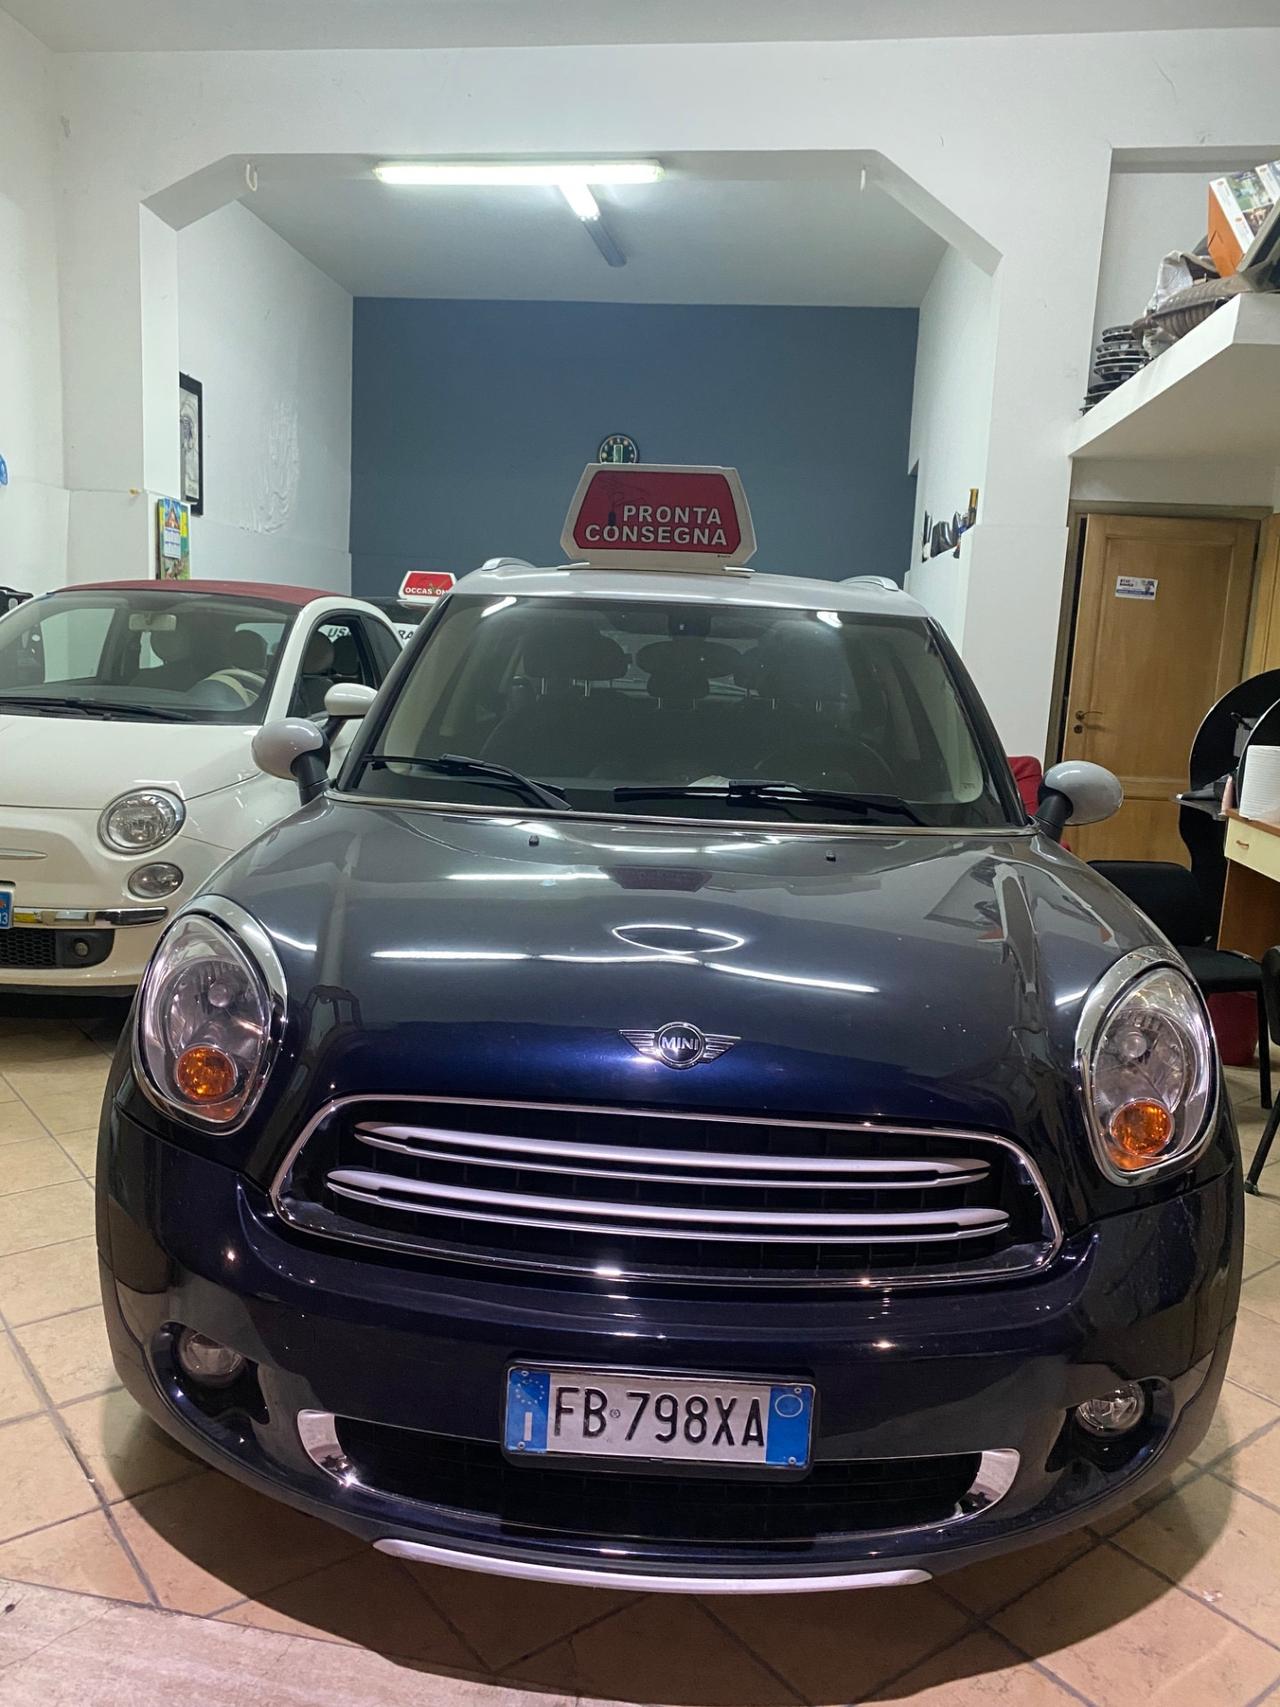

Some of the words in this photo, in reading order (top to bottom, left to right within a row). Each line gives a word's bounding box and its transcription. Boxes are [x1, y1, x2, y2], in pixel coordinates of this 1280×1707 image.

[623, 504, 722, 525] PRONTA
[585, 524, 728, 546] CONSEGNA
[661, 1036, 699, 1050] MINI
